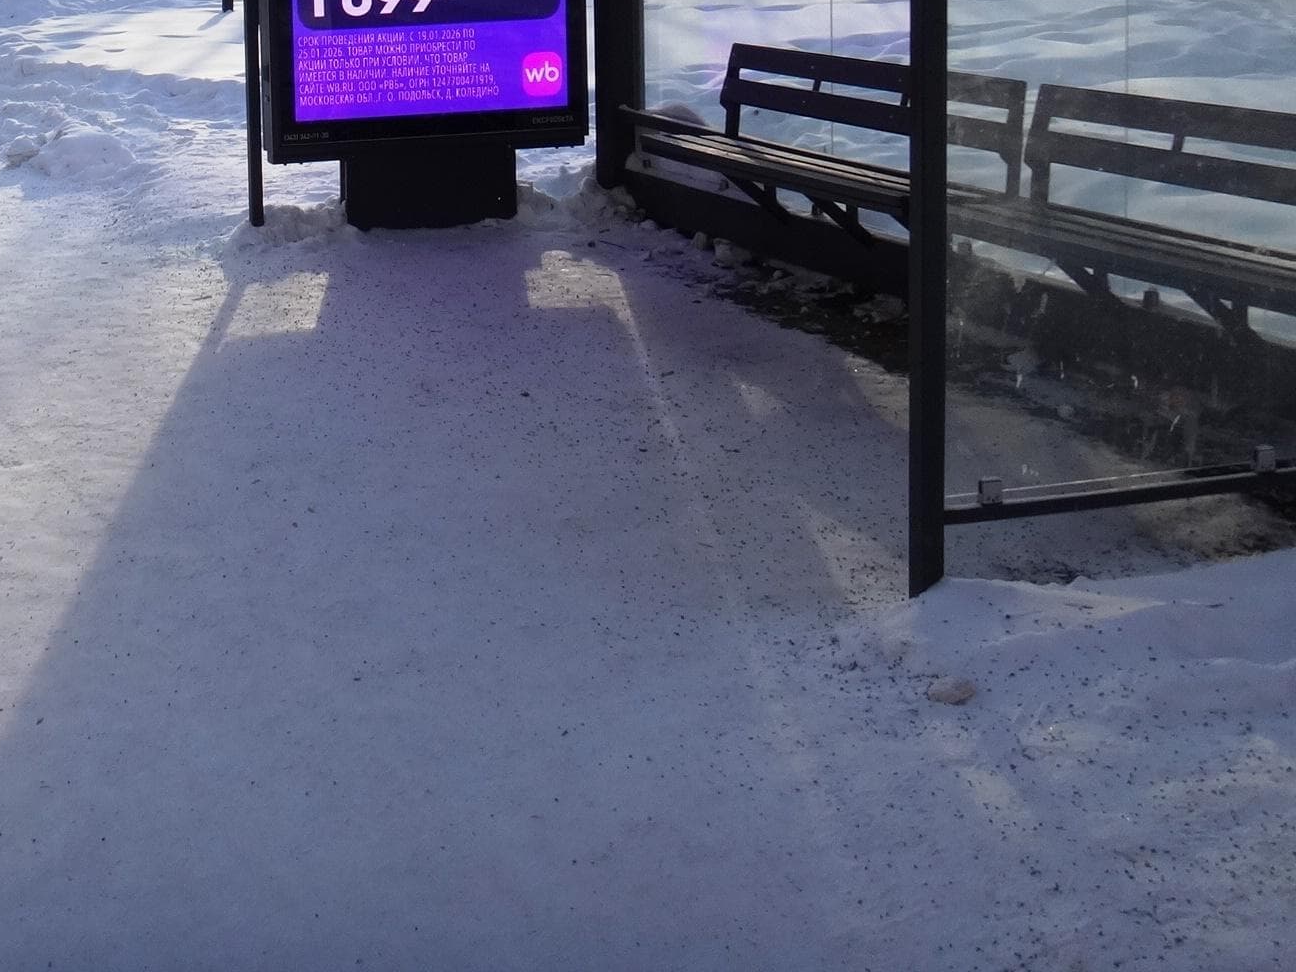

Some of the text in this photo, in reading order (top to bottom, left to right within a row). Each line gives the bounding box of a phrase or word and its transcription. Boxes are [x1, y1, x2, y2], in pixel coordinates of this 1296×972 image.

[298, 36, 319, 47] СРОК
[321, 33, 375, 46] ПРОВЕДЕНИЯ
[462, 28, 475, 38] ПО
[347, 45, 373, 56] ТОВАР
[375, 43, 407, 55] МОЖНО
[410, 41, 462, 53] ПРИОБРЕСТИ
[464, 40, 476, 50] ПО
[298, 59, 327, 71] АКЦИИ
[329, 58, 361, 69] ТОЛЬКО
[363, 57, 379, 67] ПРИ
[425, 53, 441, 64] ЧТО
[443, 51, 468, 63] ТОВАР
[299, 70, 337, 82] ИМЕЕТСЯ
[339, 70, 345, 80] В
[391, 66, 430, 77] НАЛИЧИЕ
[432, 62, 477, 76] УТОЧНЯЙТЕ
[480, 63, 491, 73] НА
[525, 62, 560, 82] wb
[299, 82, 325, 94] САЙТЕ
[358, 81, 377, 91] ООО
[409, 78, 430, 89] ОГРН
[300, 94, 354, 106] МОСКОВСКАЯ
[456, 85, 499, 98] КОЛЕДИНО
